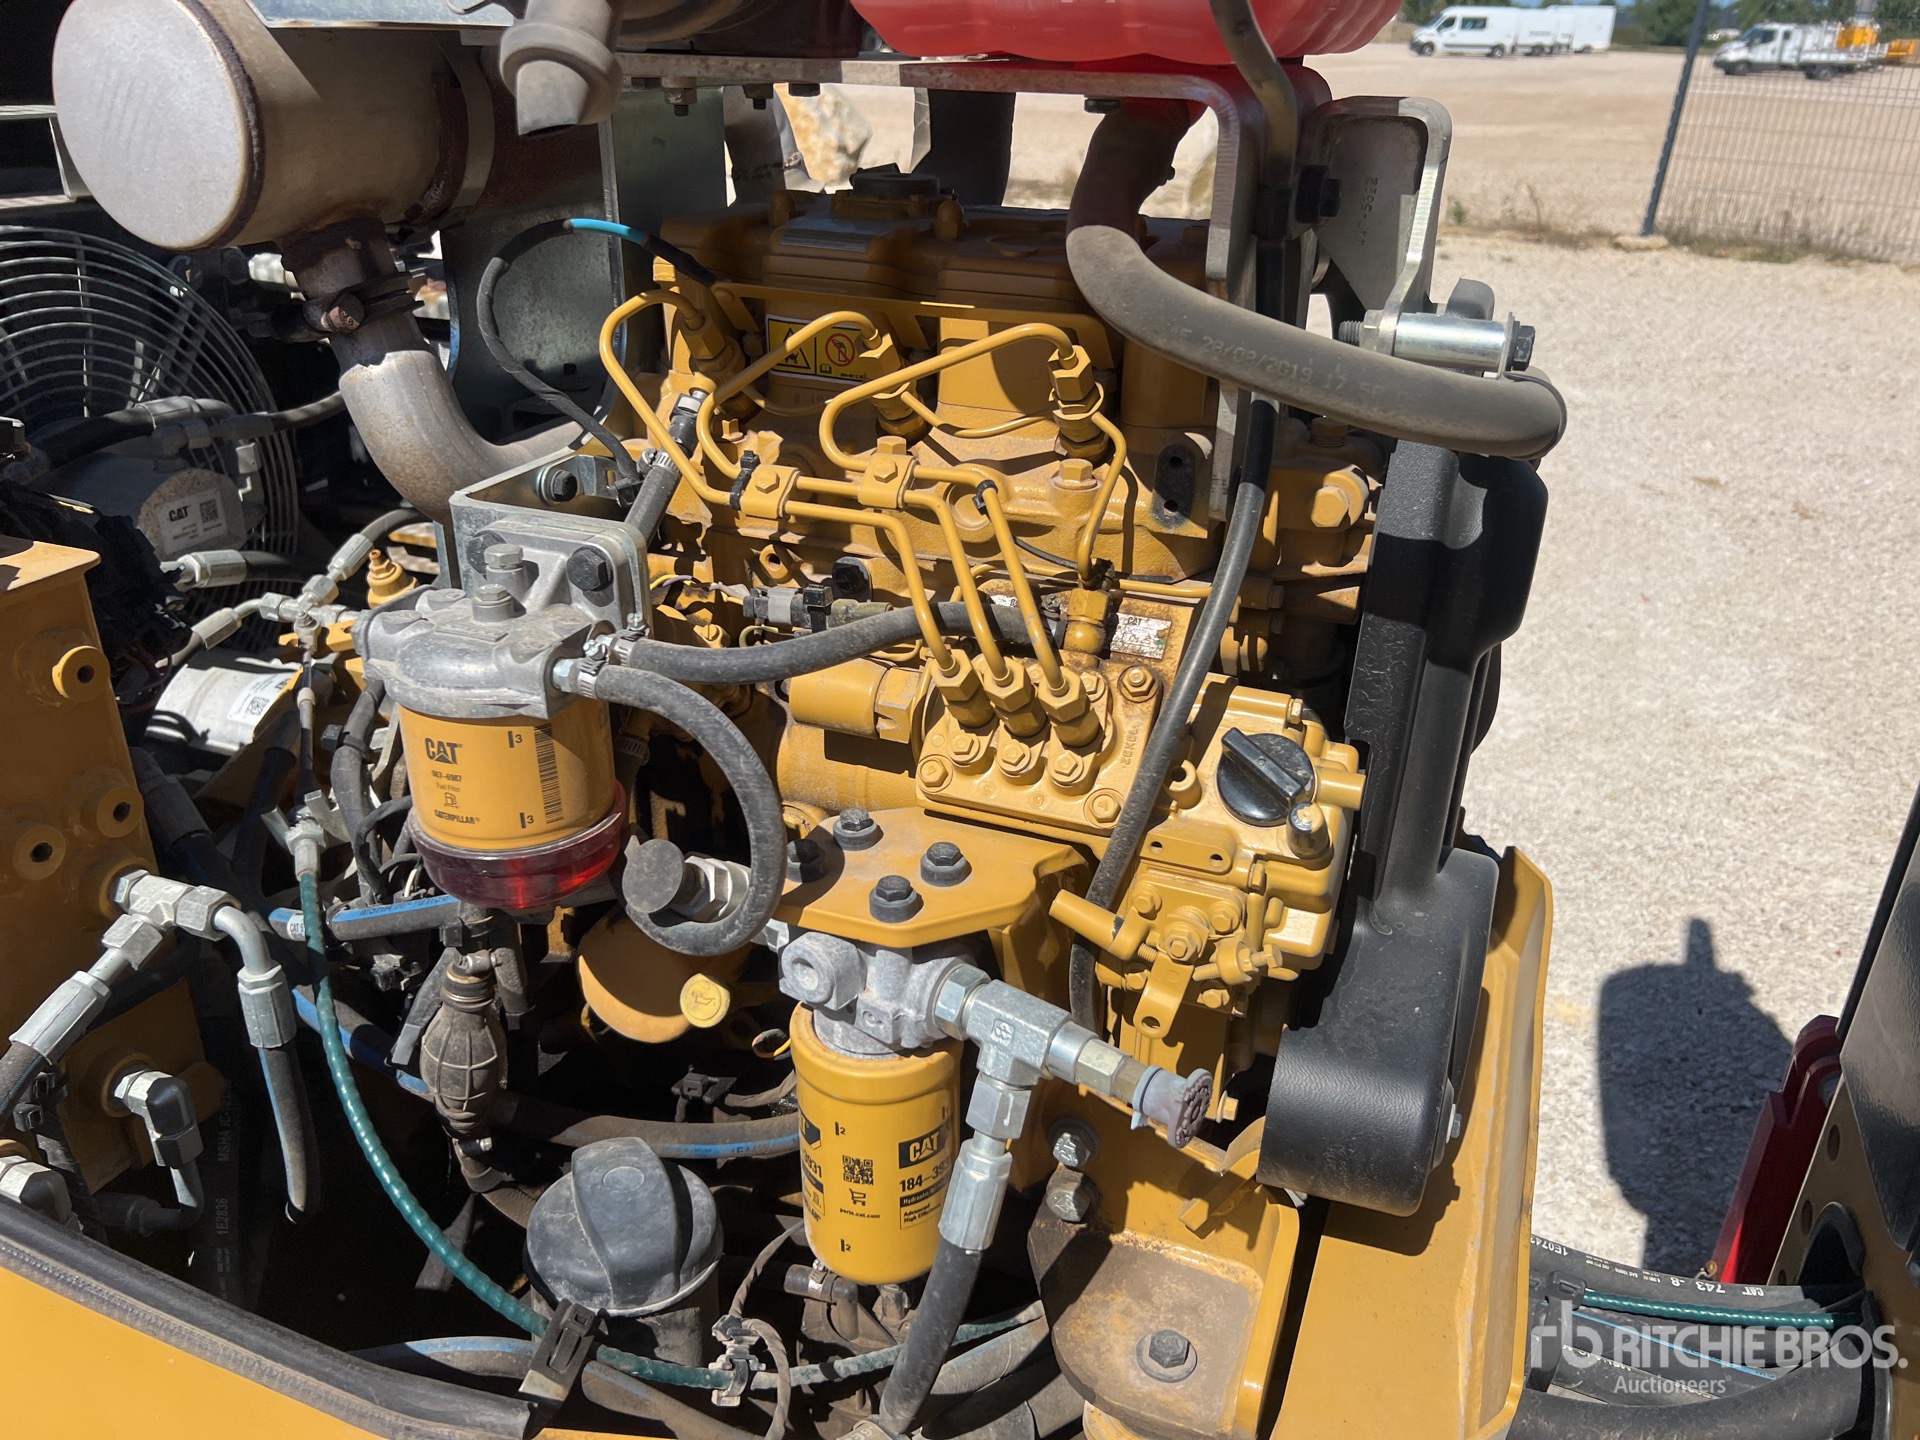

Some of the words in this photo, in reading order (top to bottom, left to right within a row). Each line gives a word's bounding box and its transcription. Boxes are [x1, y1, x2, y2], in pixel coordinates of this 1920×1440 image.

[169, 505, 190, 522] CAT
[1127, 616, 1143, 626] CAT
[425, 737, 458, 765] CAT
[909, 1131, 940, 1163] CAT
[1695, 1280, 1726, 1294] 743
[1741, 1286, 1765, 1297] CAT
